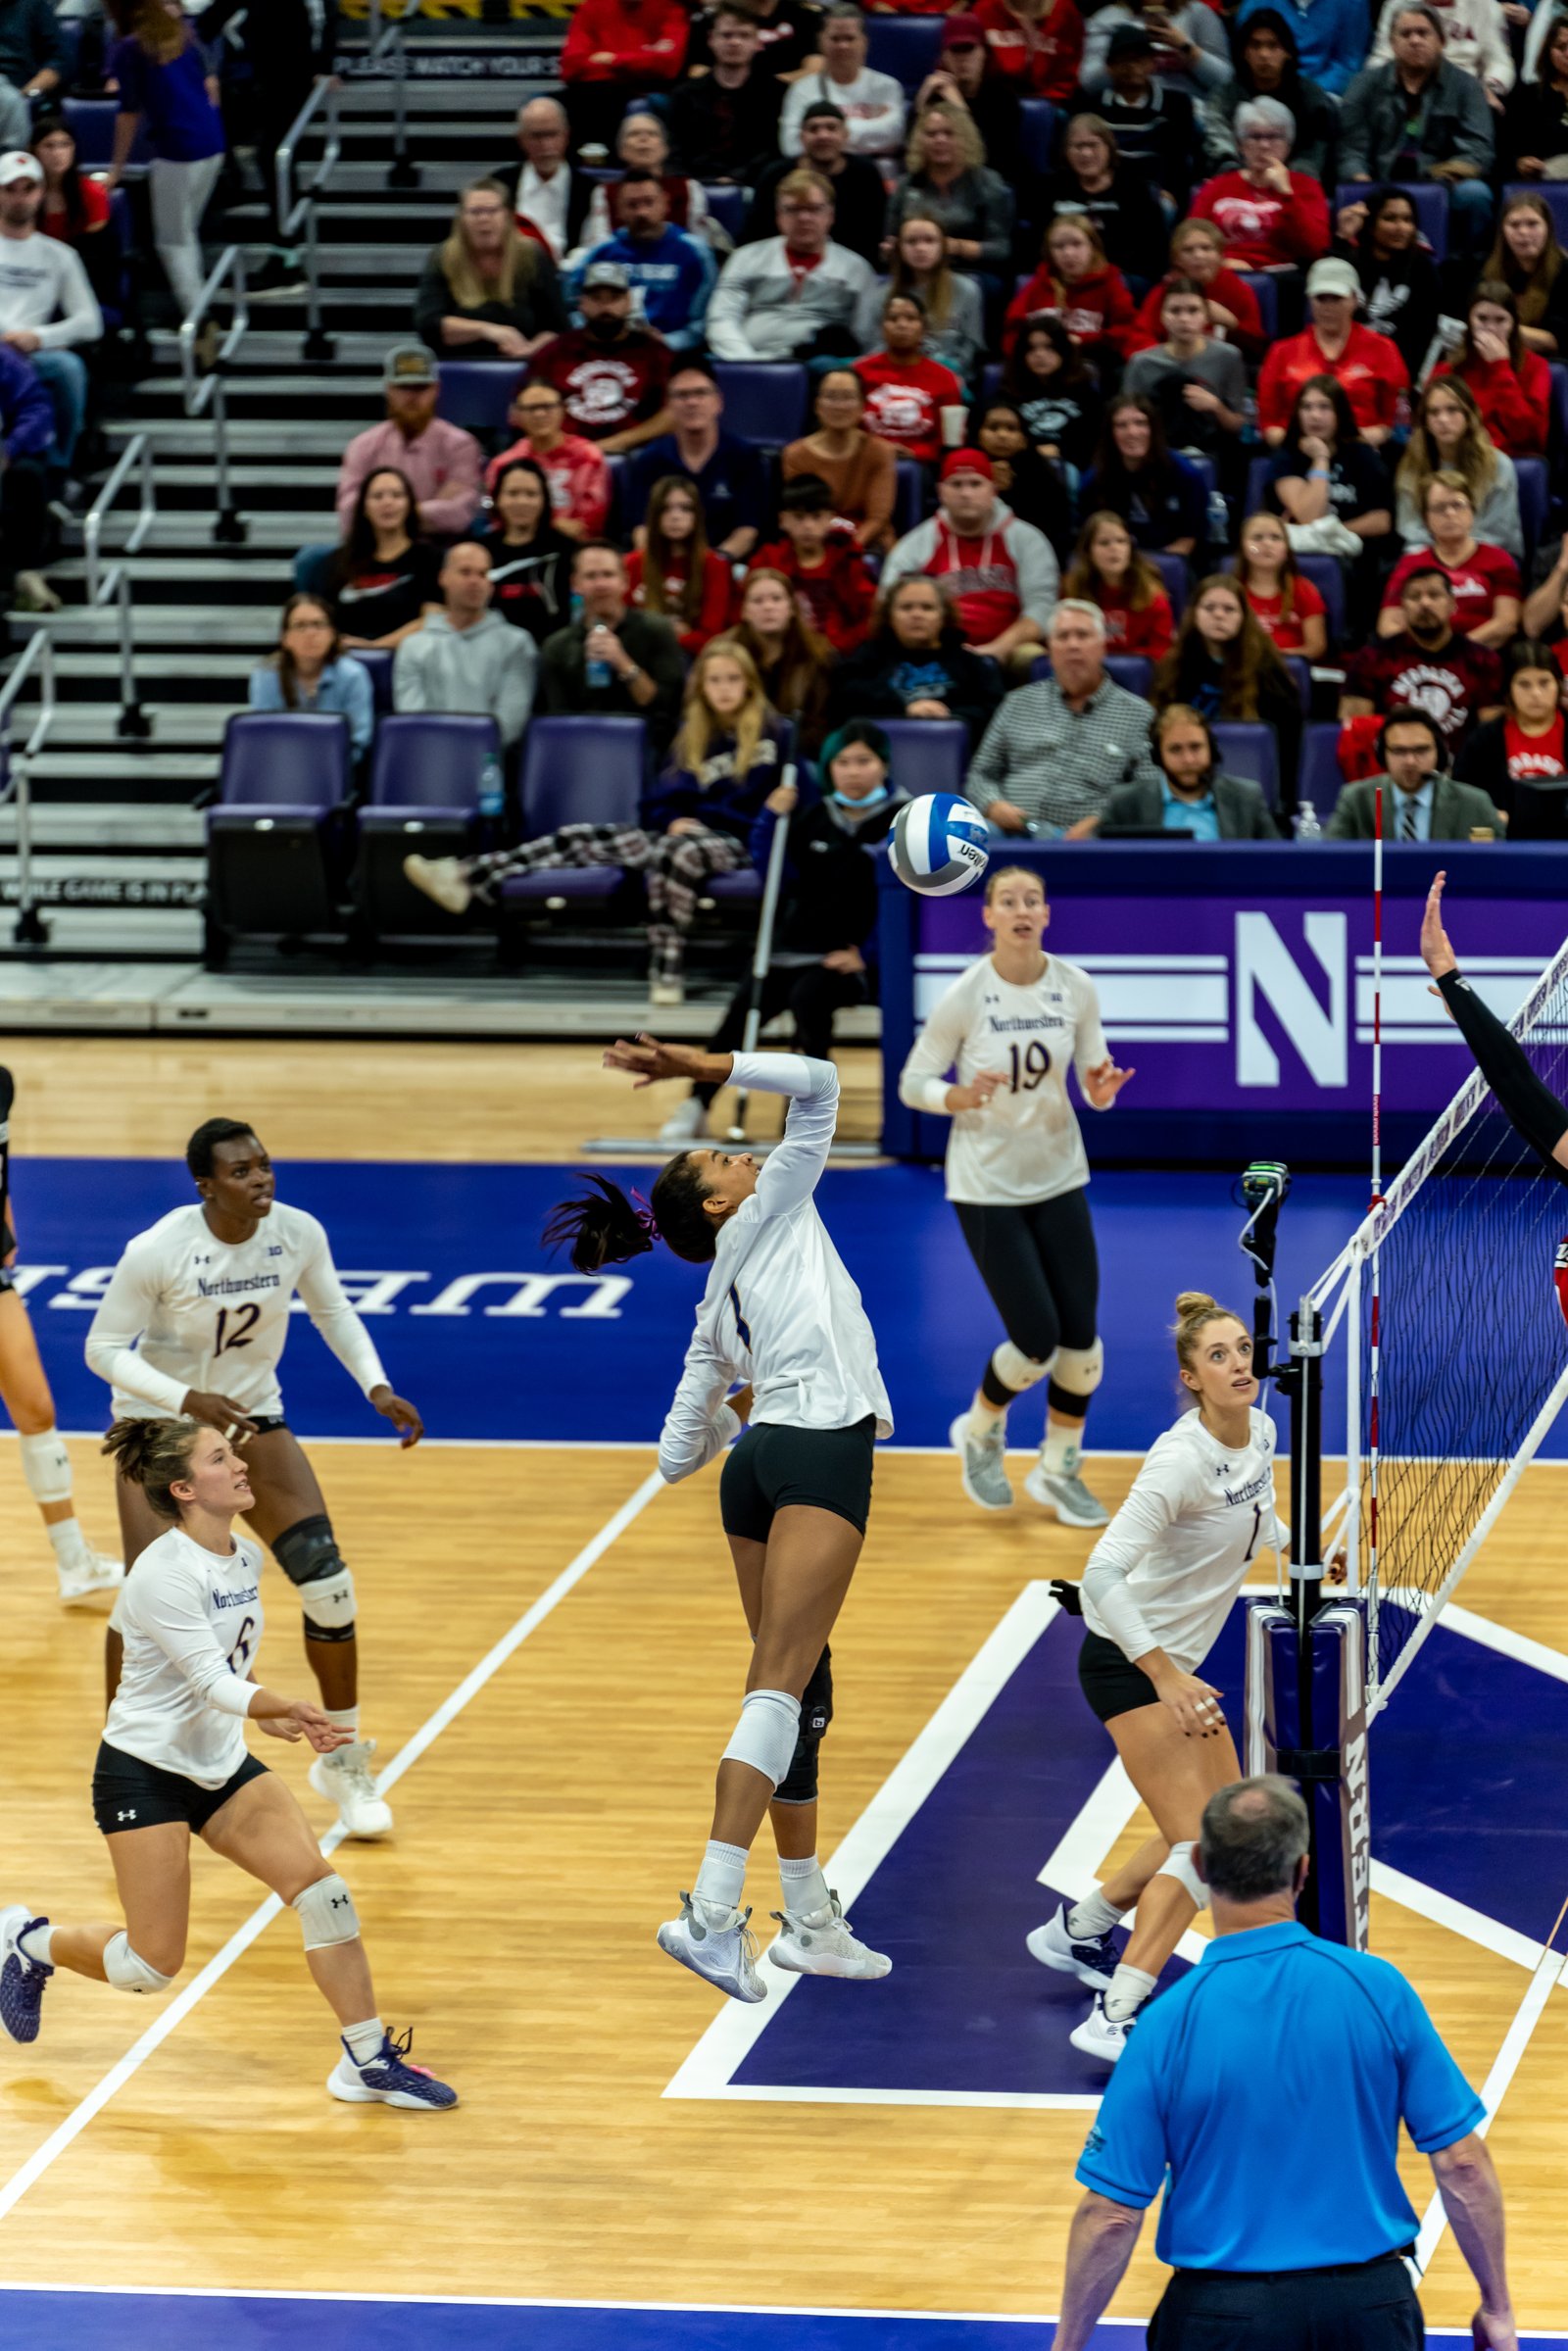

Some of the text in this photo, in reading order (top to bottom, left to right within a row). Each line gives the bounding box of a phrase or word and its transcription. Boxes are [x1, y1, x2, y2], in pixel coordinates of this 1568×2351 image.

[64, 880, 122, 902] GAME
[171, 881, 208, 904] PLA
[990, 1014, 1064, 1032] Northwestern
[1235, 910, 1348, 1089] N
[1009, 1039, 1053, 1095] 19
[198, 1273, 280, 1297] Northwestern
[213, 1302, 261, 1358] 12
[1243, 1501, 1261, 1562] 1
[226, 1616, 255, 1675] 6
